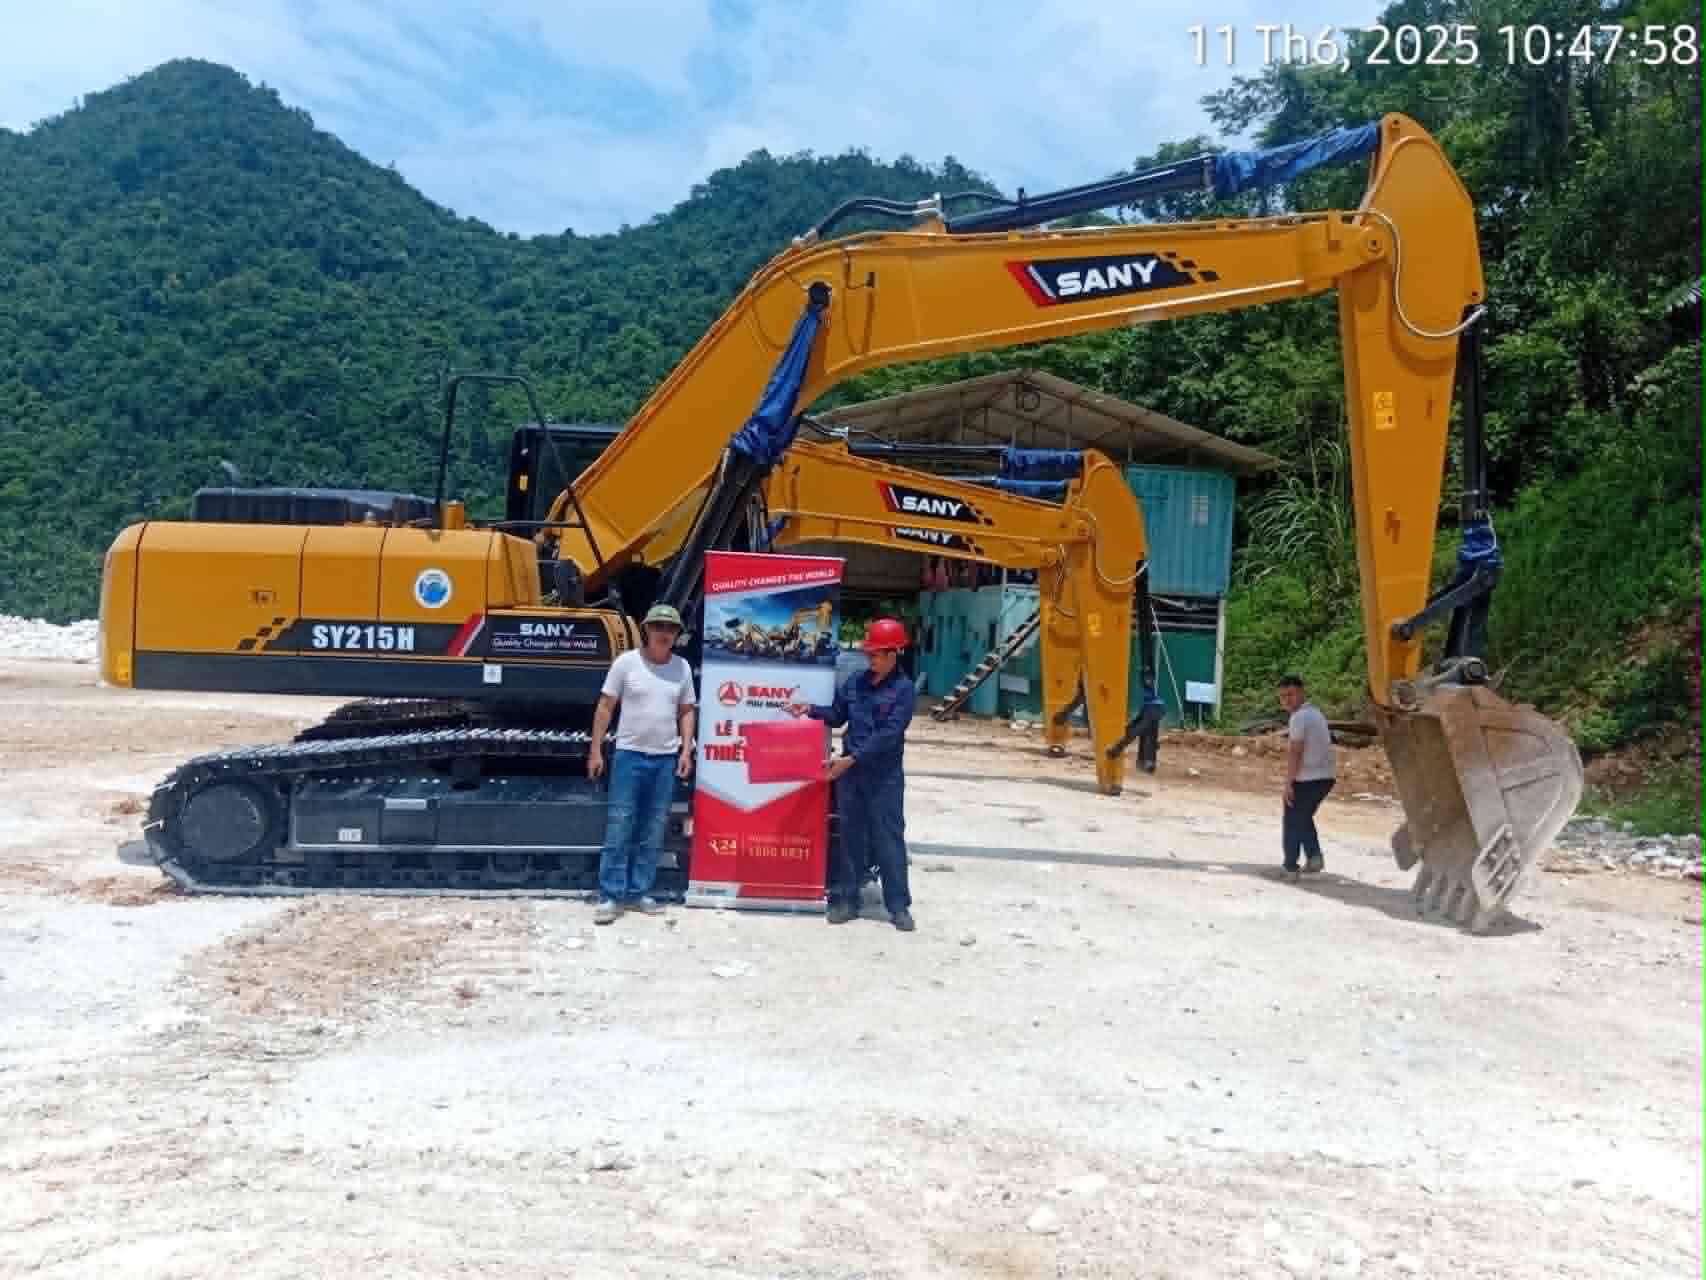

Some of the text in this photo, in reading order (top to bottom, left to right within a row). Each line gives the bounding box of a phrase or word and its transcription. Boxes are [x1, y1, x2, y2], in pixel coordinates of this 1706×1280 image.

[1056, 258, 1159, 297] SANY
[902, 495, 961, 517] SANY
[311, 623, 415, 651] SY215H
[519, 623, 576, 637] SANY
[745, 686, 793, 699] SANY
